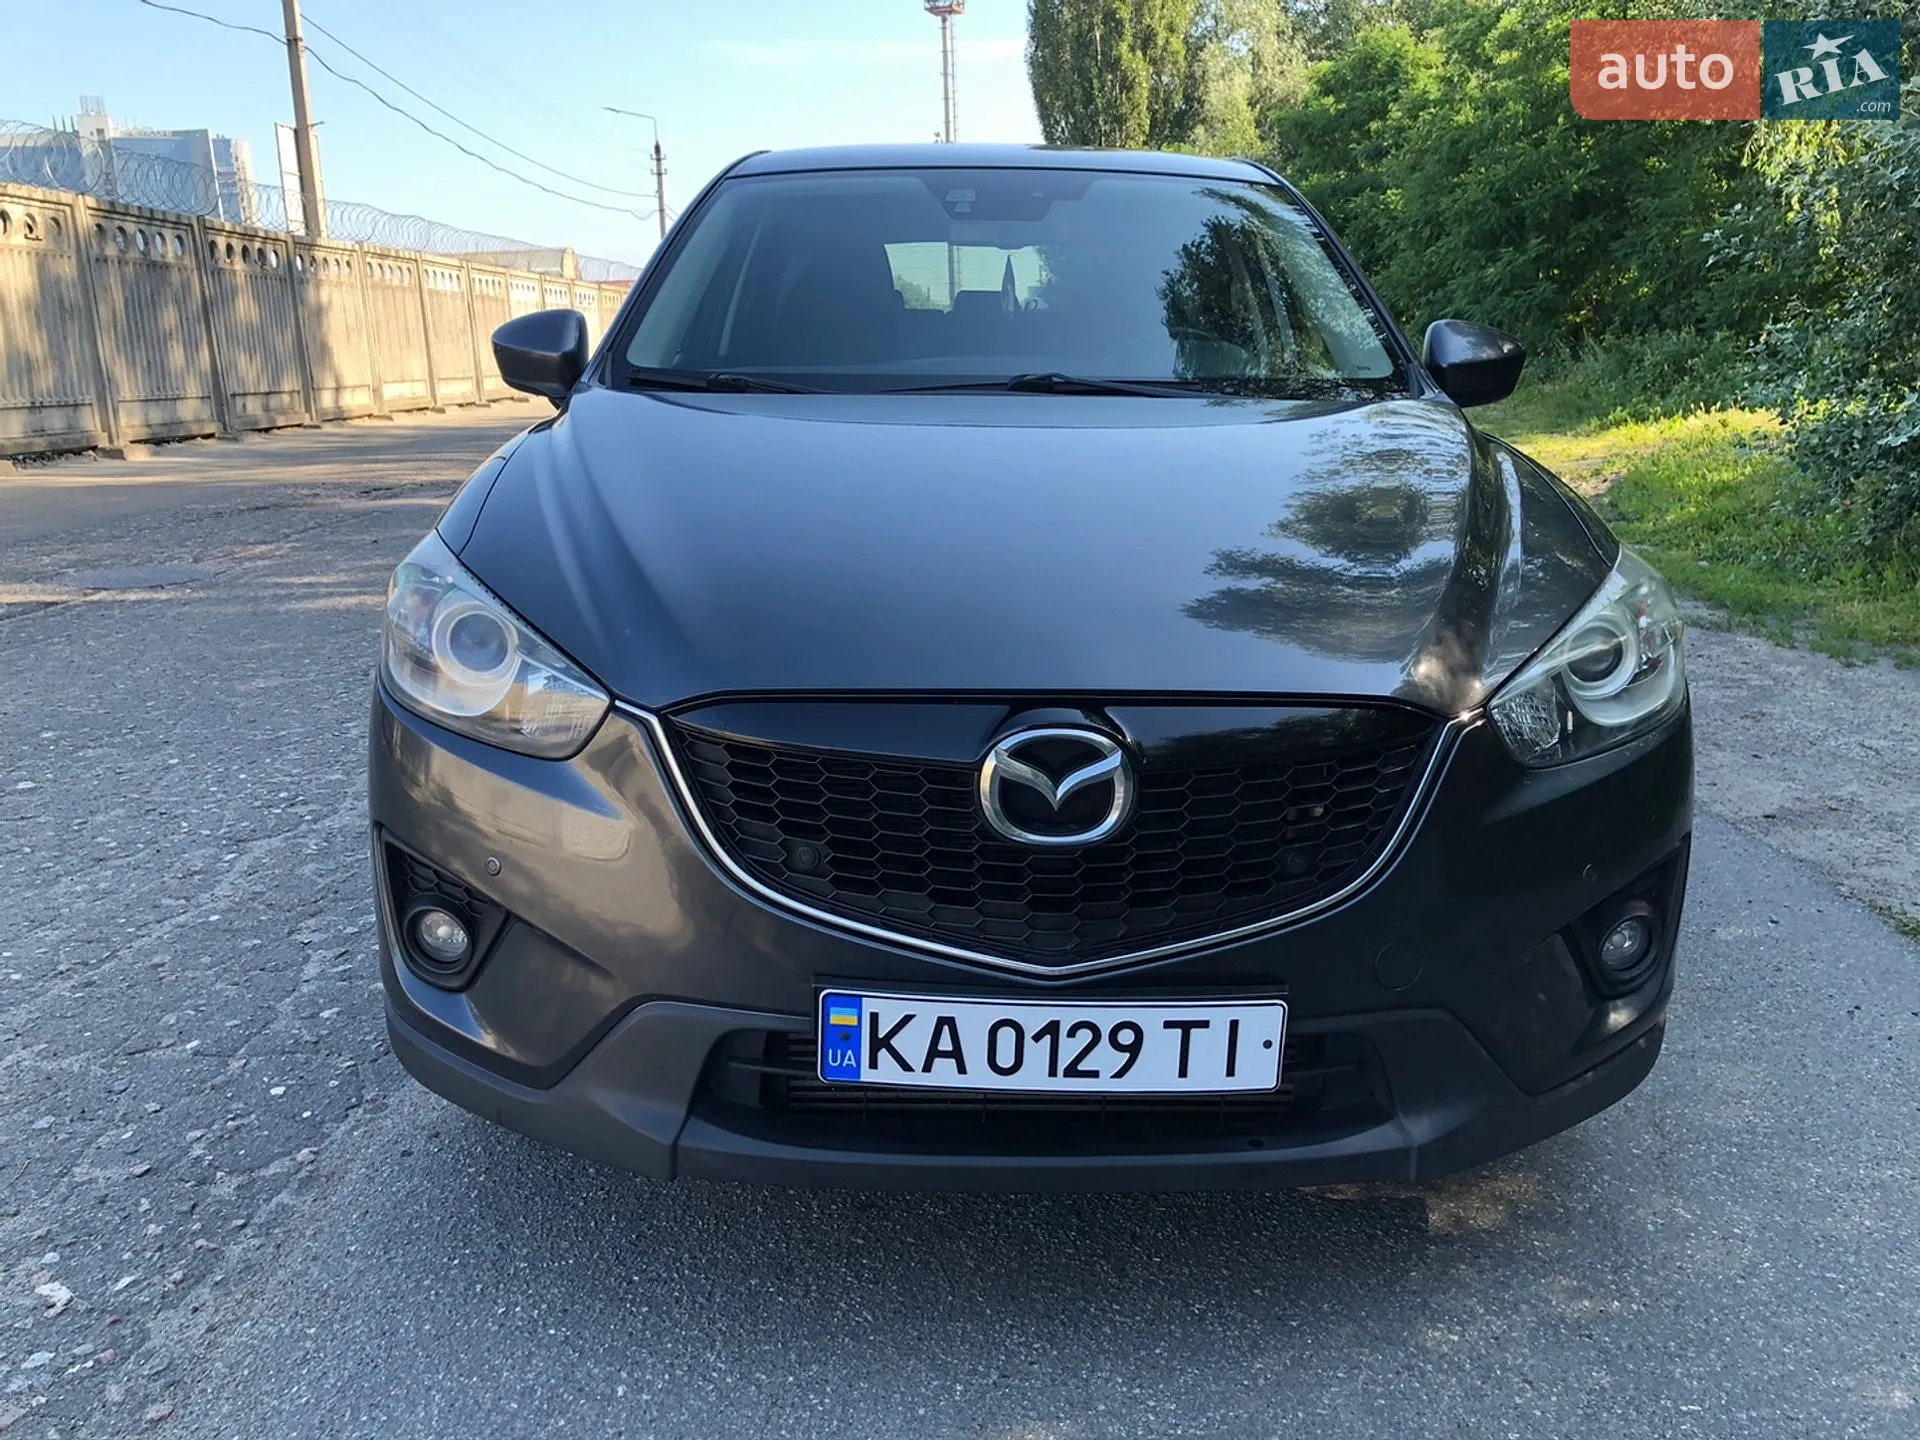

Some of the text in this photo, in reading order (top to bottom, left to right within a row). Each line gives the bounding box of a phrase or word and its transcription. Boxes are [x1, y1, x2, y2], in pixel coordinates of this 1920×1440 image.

[827, 1048, 857, 1069] UA
[867, 1011, 1240, 1080] KA 0129 TI
